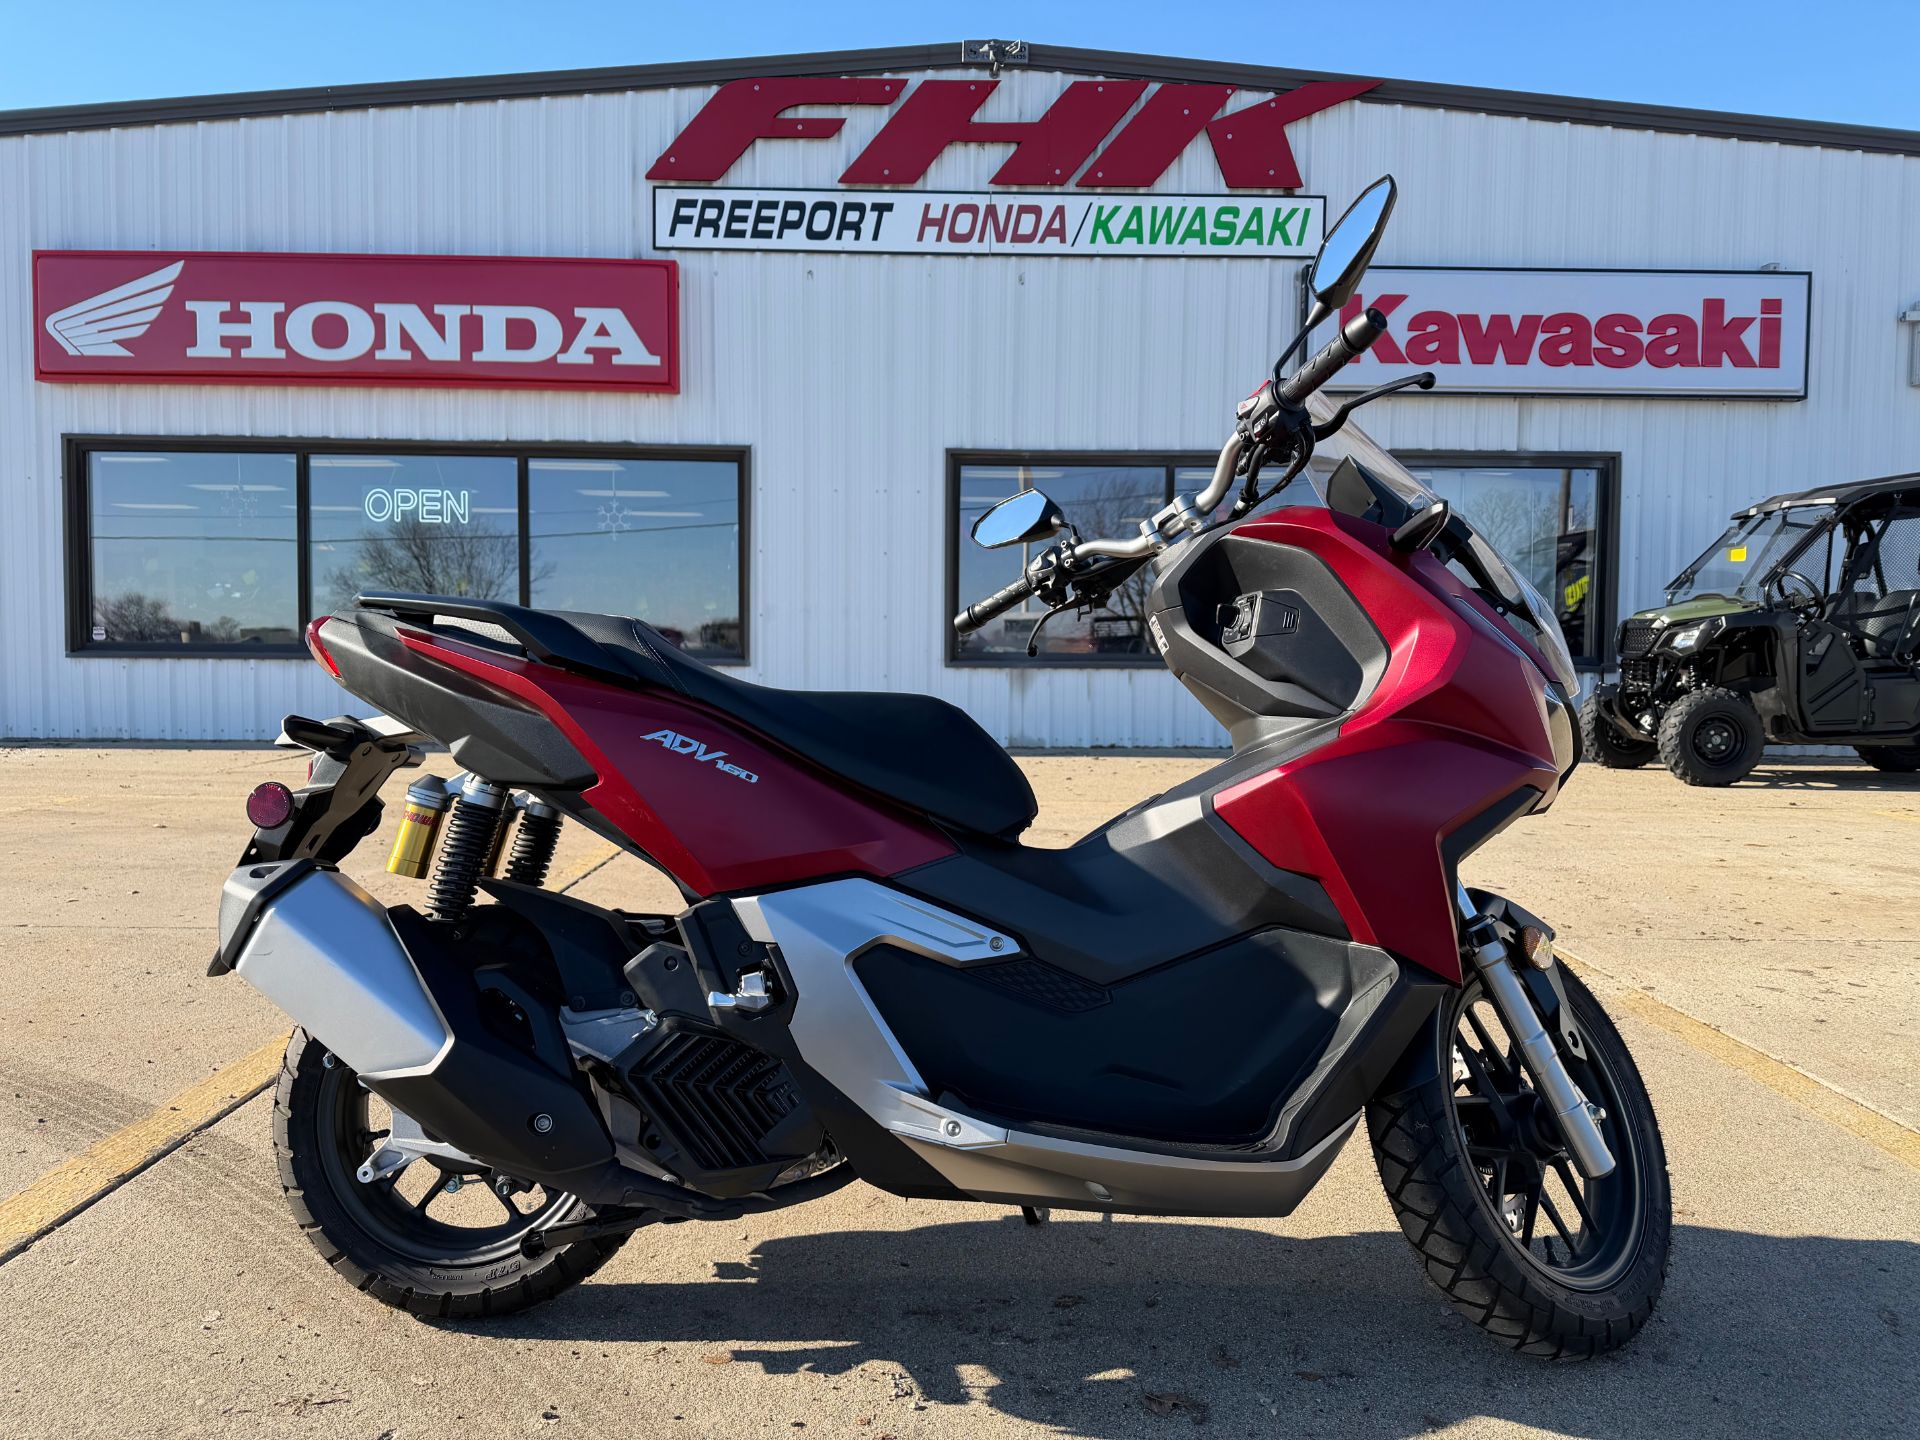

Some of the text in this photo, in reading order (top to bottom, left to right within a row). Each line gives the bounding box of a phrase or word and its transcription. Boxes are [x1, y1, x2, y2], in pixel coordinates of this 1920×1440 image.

[645, 77, 1383, 189] FHK
[668, 199, 894, 242] FREEPORT
[185, 301, 661, 366] HONDA
[1340, 293, 1782, 369] Kawasaki
[364, 488, 469, 524] OPEN
